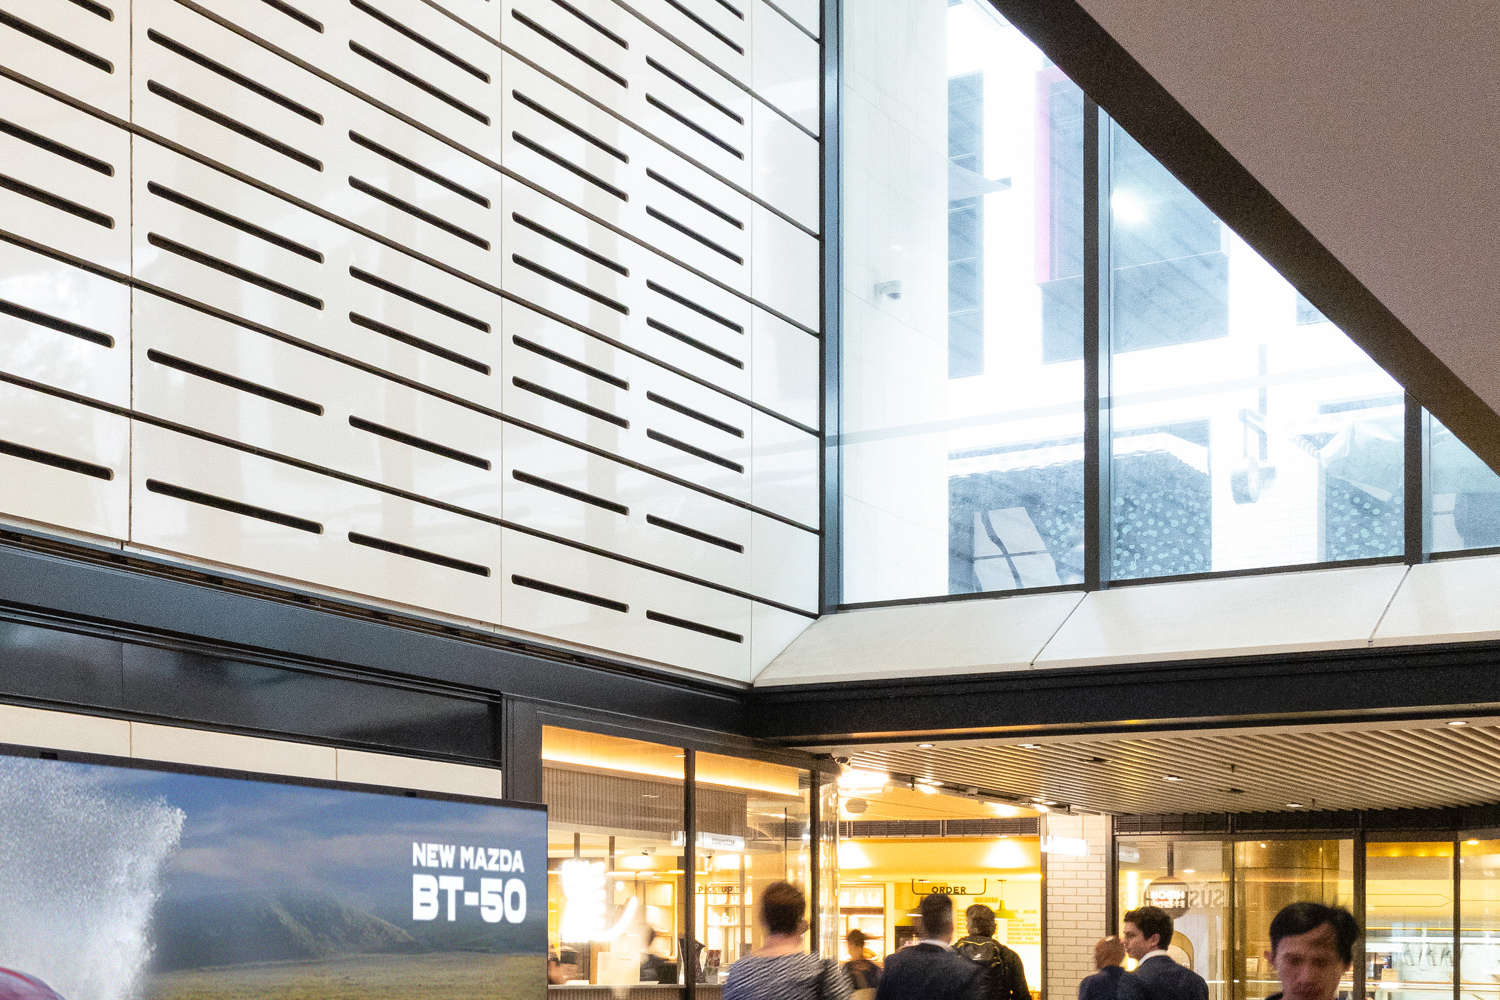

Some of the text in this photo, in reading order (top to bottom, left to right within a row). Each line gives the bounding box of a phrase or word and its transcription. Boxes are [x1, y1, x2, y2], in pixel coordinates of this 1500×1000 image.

[412, 842, 525, 873] NEW MAZDA
[412, 873, 527, 924] BT-50
[931, 886, 967, 895] ORDER
